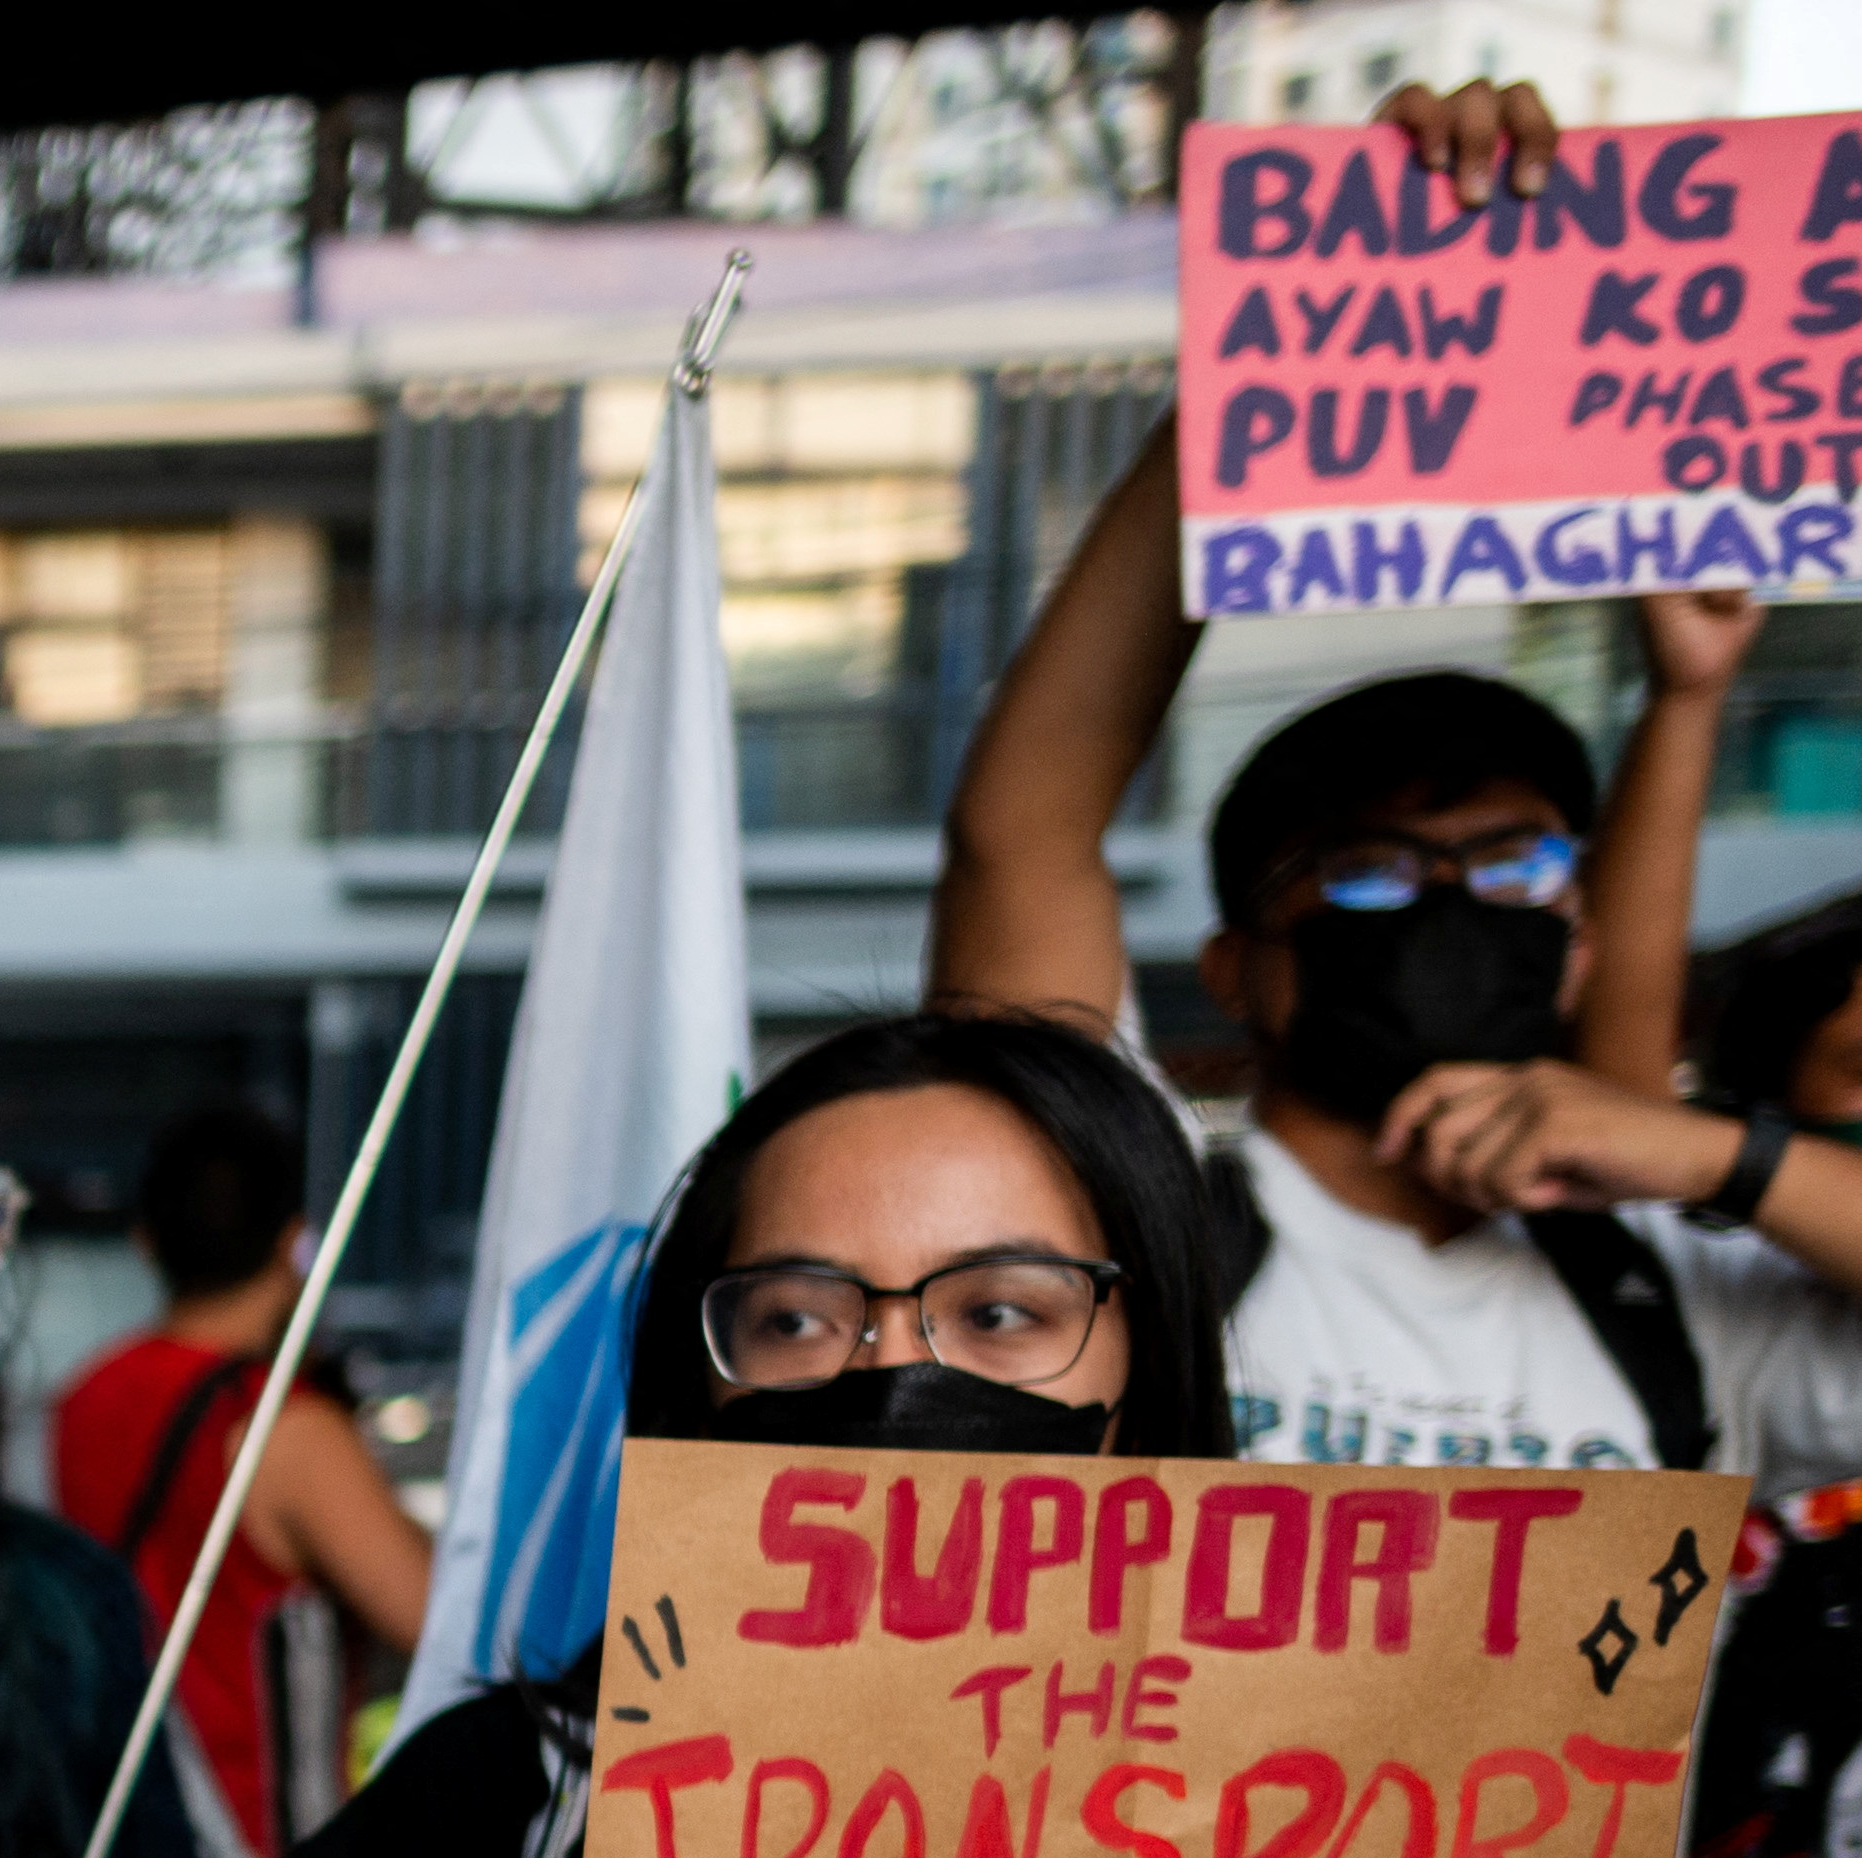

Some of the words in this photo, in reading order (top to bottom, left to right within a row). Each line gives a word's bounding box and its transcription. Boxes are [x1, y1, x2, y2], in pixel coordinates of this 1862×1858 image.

[1217, 132, 1738, 261] BADING
[1218, 284, 1506, 361] AYAW
[1579, 263, 1747, 348] KO
[1214, 383, 1477, 490] PUV
[737, 1465, 1584, 1658] SUPPORT
[950, 1653, 1193, 1758] THE
